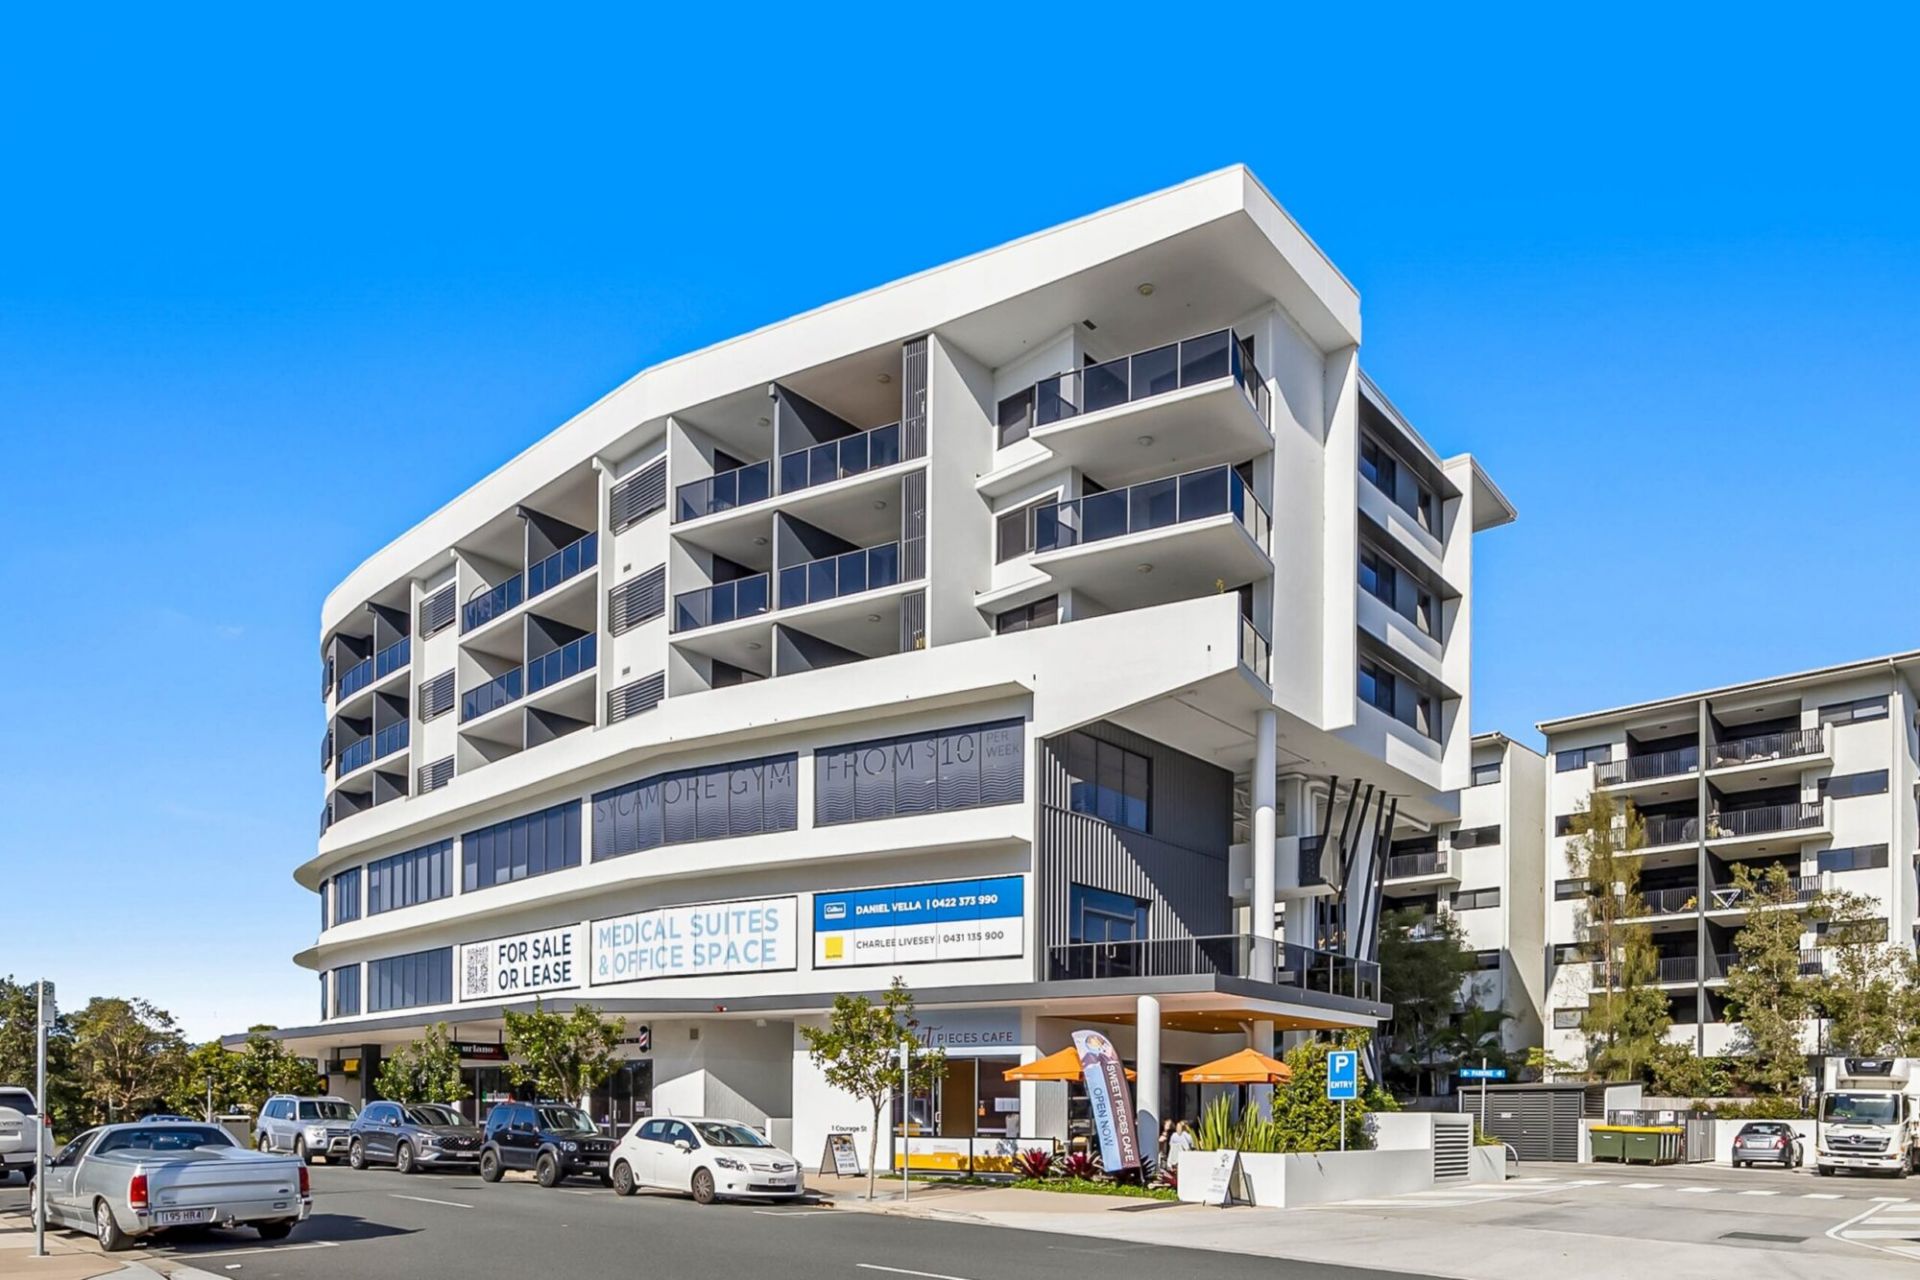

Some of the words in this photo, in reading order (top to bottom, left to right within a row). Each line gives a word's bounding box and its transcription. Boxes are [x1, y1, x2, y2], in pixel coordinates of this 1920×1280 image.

[986, 731, 1008, 742] PER
[827, 744, 914, 780] FROM
[986, 743, 1020, 757] WEEK
[597, 775, 717, 822] SYCAMORE
[729, 761, 790, 795] GYM
[856, 904, 890, 915] DANIEL
[891, 901, 922, 912] VELLA
[932, 898, 956, 908] 0422
[978, 894, 998, 904] 990
[599, 917, 681, 949] MEDICAL
[690, 908, 779, 938] SUITES
[856, 939, 896, 949] CHARLEE
[898, 936, 935, 946] LIVESEY
[943, 934, 964, 943] 0431
[967, 932, 981, 941] 135
[985, 931, 1004, 940] 900
[499, 942, 528, 965] FOR
[533, 934, 571, 959] SALE
[599, 955, 608, 976] &
[615, 945, 683, 974] OFFICE
[693, 938, 777, 966] SPACE
[499, 969, 518, 989] OR
[524, 961, 571, 987] LEASE
[937, 1033, 978, 1043] PIECES
[982, 1031, 1013, 1042] CAFE
[1335, 1055, 1349, 1074] P
[1331, 1080, 1353, 1089] ENTRY
[1093, 1087, 1108, 1118] OPEN
[1107, 1064, 1121, 1097] SWEET
[1115, 1101, 1129, 1135] PIECES
[1122, 1136, 1134, 1162] CAFE
[836, 1125, 860, 1133] Courage
[1100, 1120, 1114, 1146] NOW
